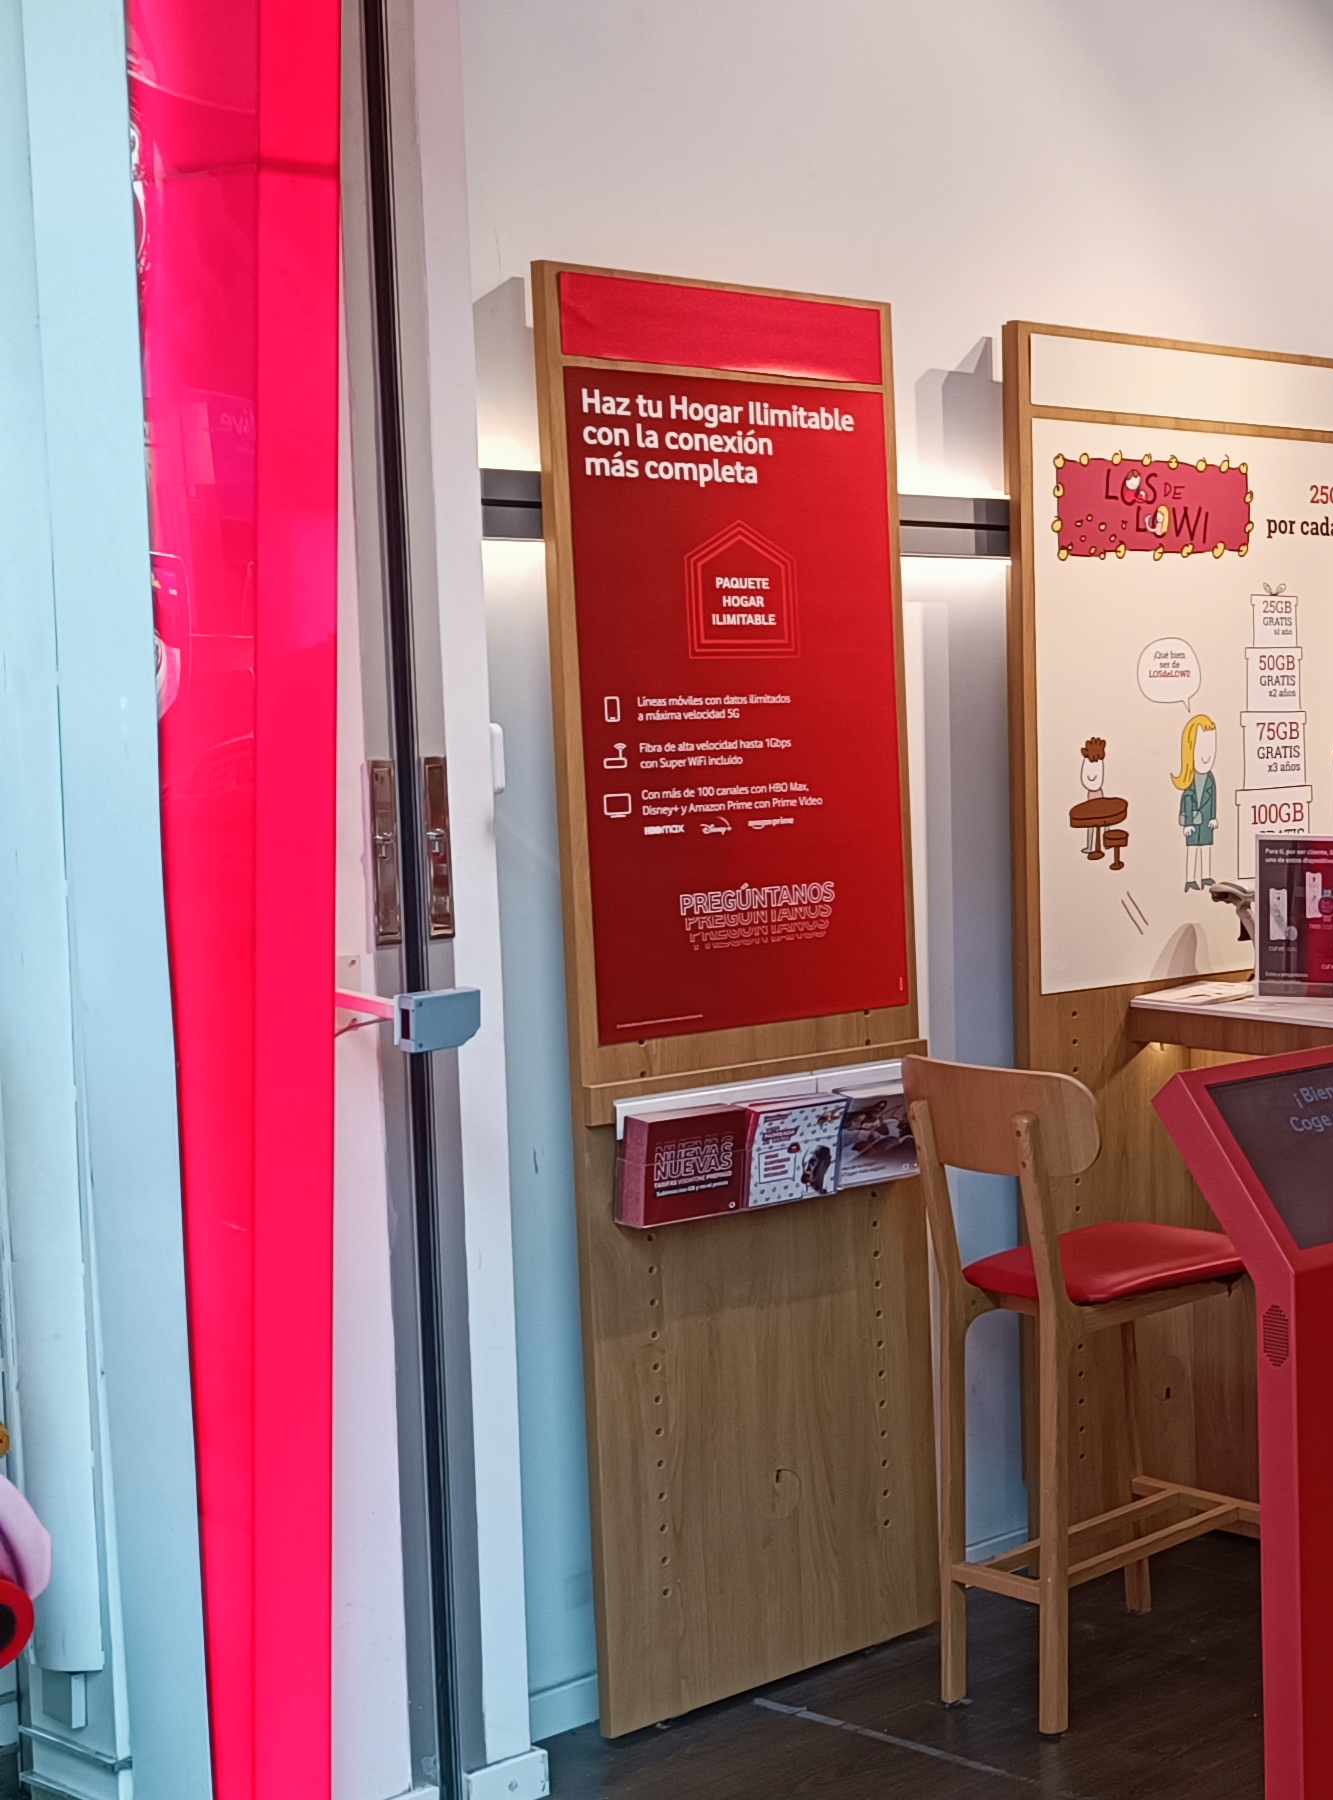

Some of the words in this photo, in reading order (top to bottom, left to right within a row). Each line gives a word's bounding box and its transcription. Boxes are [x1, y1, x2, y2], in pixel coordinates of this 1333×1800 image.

[581, 388, 631, 416] Haz
[636, 395, 662, 418] tu
[670, 395, 743, 428] Hogar
[749, 401, 855, 432] Ilimitable
[583, 425, 629, 446] con
[636, 423, 659, 449] la
[665, 429, 773, 455] conexión
[585, 451, 639, 478] más
[644, 459, 758, 487] completa
[1104, 468, 1158, 505] LOS
[1163, 482, 1185, 500] DE
[1135, 505, 1209, 545] LOWI
[1267, 518, 1295, 538] por
[715, 577, 770, 590] PAQUETE
[722, 596, 765, 607] HOGAR
[1262, 600, 1292, 614] 25GB
[712, 614, 777, 626] ILIMITABLE
[1262, 617, 1292, 627] GRATIS
[1170, 651, 1185, 659] bien
[1259, 655, 1295, 671] 50GB
[1259, 675, 1296, 687] GRATIS
[637, 696, 667, 707] Líneas
[668, 695, 703, 706] móviles
[705, 697, 722, 706] con
[724, 694, 747, 705] datos
[749, 693, 791, 704] ilimitados
[638, 713, 644, 721] a
[645, 709, 681, 721] máxima
[683, 709, 725, 720] velocidad
[727, 708, 740, 719] 5G
[1256, 722, 1300, 744] 75GB
[639, 742, 662, 753] Fibra
[664, 741, 676, 752] de
[677, 741, 695, 752] alta
[696, 739, 738, 750] velocidad
[740, 738, 763, 749] hasta
[766, 737, 792, 749] 1Gbps
[1256, 745, 1301, 760] GRATIS
[640, 760, 658, 769] con
[660, 758, 686, 770] Super
[688, 756, 706, 767] WiFi
[708, 754, 743, 765] incluido
[1268, 763, 1278, 773] x3
[1280, 761, 1301, 772] años
[642, 804, 679, 817] Disney+
[681, 806, 688, 816] y
[688, 802, 725, 814] Amazon
[727, 800, 754, 811] Prime
[754, 800, 770, 809] con
[772, 797, 797, 808] Prime
[798, 796, 823, 806] Video
[1251, 802, 1305, 826] 100GB
[680, 881, 835, 916] PREGÚNTANOS
[1289, 1114, 1332, 1132] Coge
[654, 1153, 733, 1181] NUEVAS
